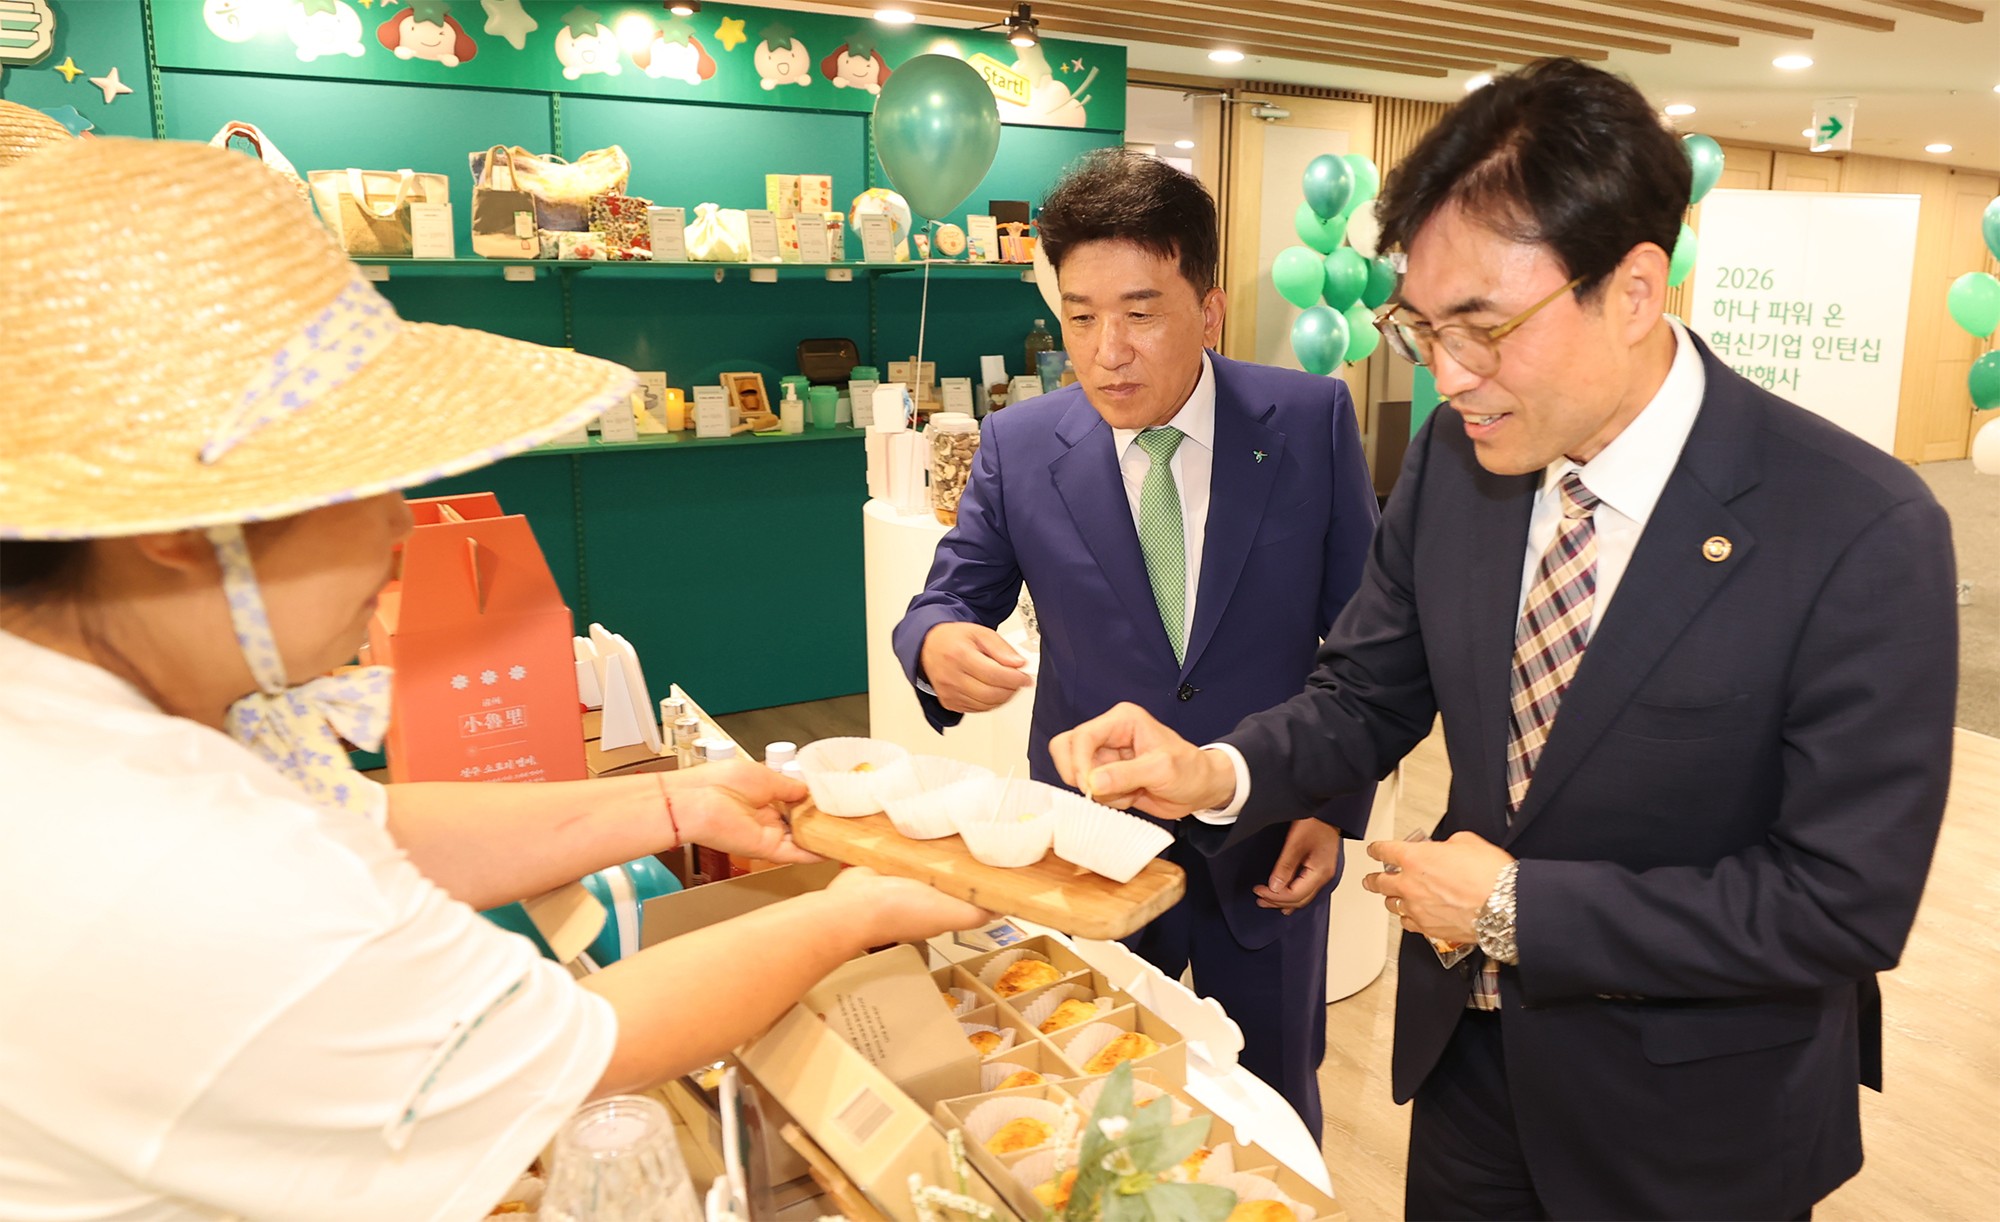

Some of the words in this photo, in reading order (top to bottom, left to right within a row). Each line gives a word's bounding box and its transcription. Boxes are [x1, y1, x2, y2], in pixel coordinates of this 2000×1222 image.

[984, 66, 1023, 96] Start!
[1716, 266, 1774, 290] 2026
[1713, 299, 1760, 324] 하나
[1768, 301, 1812, 326] 파워
[1823, 303, 1845, 328] 온
[1711, 331, 1802, 359] 혁신기업
[1812, 336, 1881, 363] 인턴십
